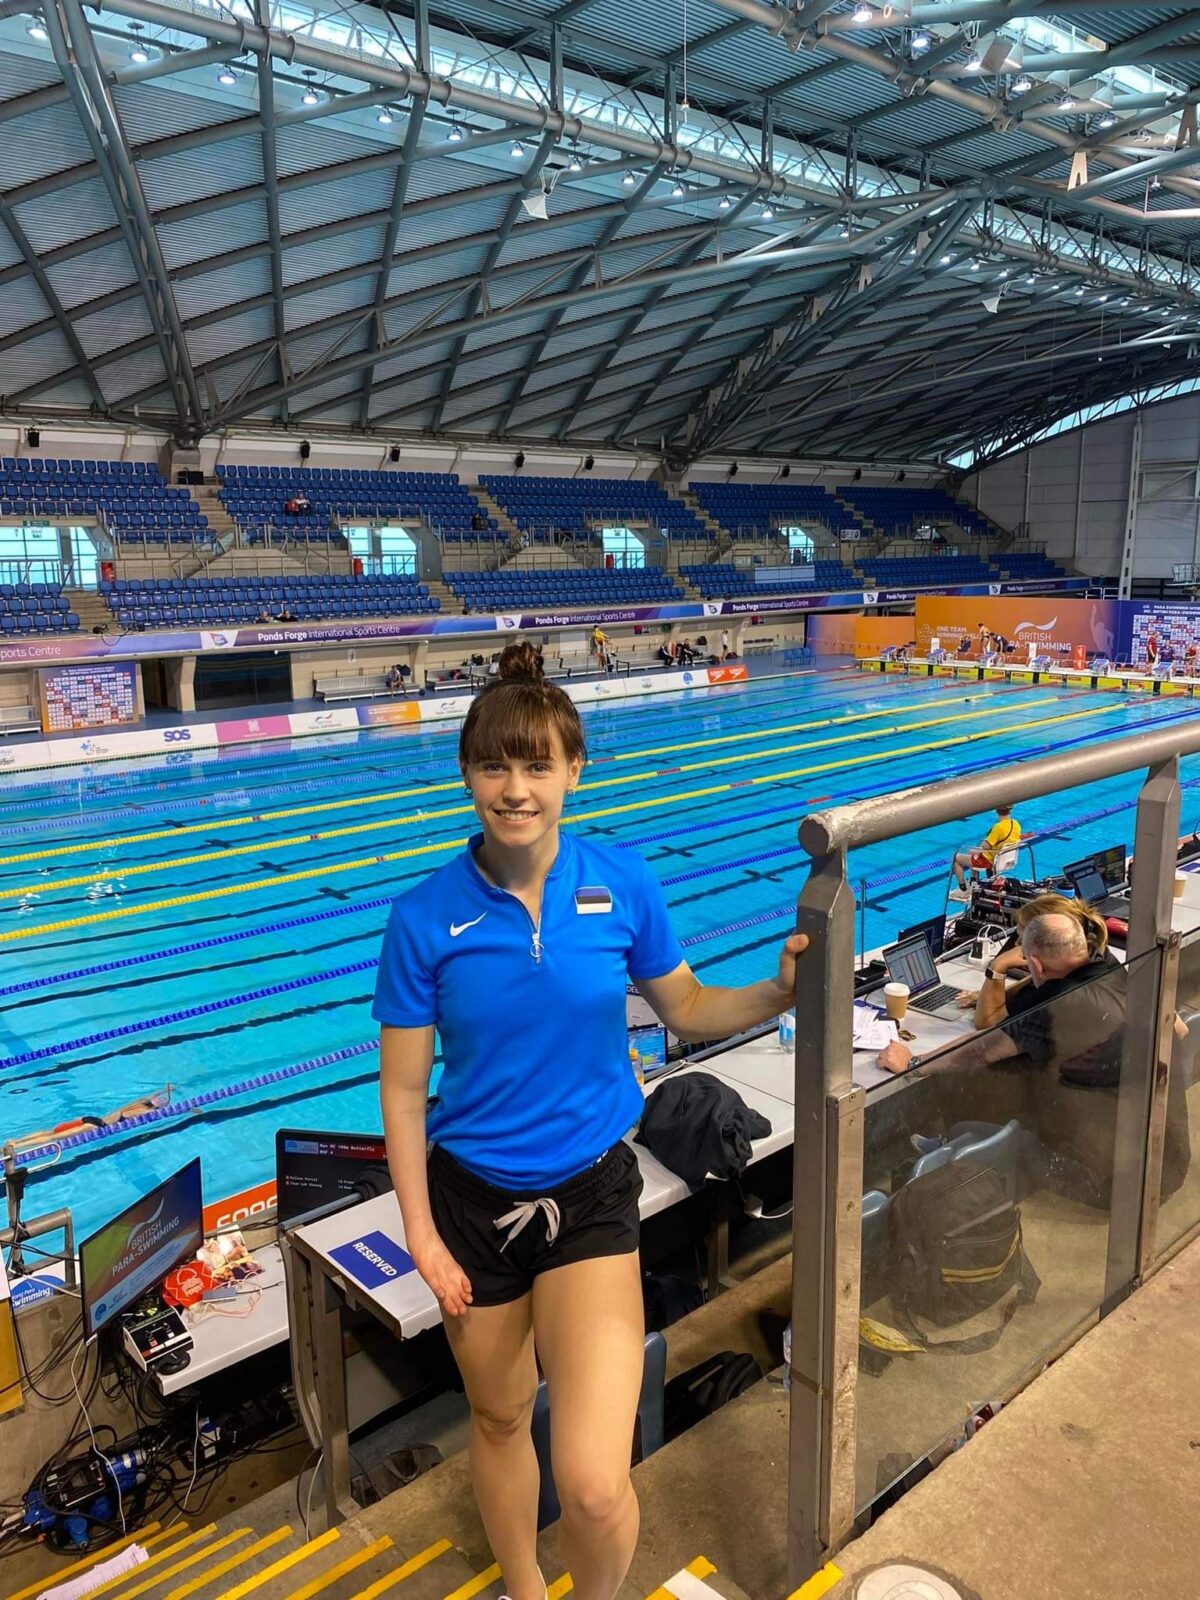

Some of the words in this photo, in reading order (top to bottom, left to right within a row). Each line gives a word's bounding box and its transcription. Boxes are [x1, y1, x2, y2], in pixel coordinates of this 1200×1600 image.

[746, 603, 759, 612] Forge
[535, 617, 553, 625] Ponds
[553, 616, 569, 625] Forge
[570, 614, 602, 622] International
[602, 612, 619, 621] Sports
[619, 611, 636, 619] Centre
[258, 632, 283, 642] Ponds
[284, 631, 307, 641] Forge
[308, 627, 353, 638] International
[354, 626, 377, 637] Sports
[378, 624, 400, 634] Centre
[1018, 632, 1052, 641] BRITISH
[0, 648, 27, 660] ports
[28, 646, 62, 657] Centre
[163, 729, 192, 742] SOS
[626, 985, 640, 993] DEL
[131, 1219, 162, 1250] BRITISH
[112, 1216, 180, 1277] PARA-SWIMMING
[352, 1241, 397, 1277] RESERVED
[13, 1287, 51, 1307] wimming
